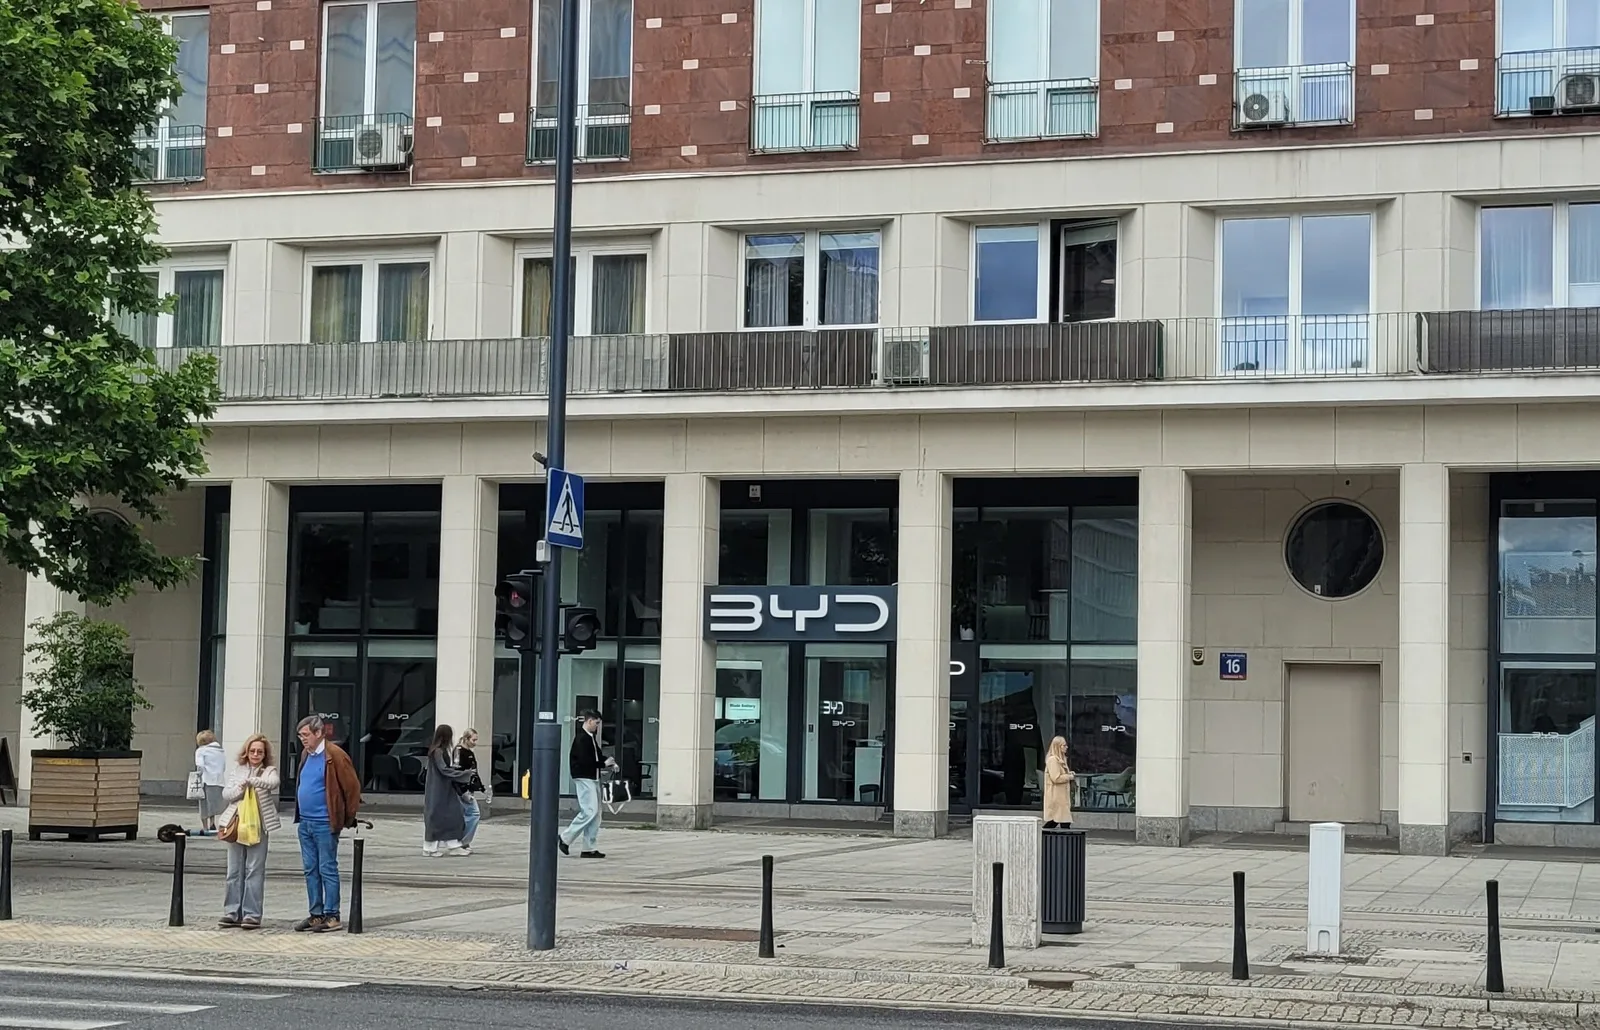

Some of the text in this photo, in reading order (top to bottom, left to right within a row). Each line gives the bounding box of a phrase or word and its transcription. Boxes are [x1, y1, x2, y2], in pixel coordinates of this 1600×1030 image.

[710, 594, 889, 632] BYD
[1225, 658, 1241, 674] 16
[823, 700, 844, 715] BYD
